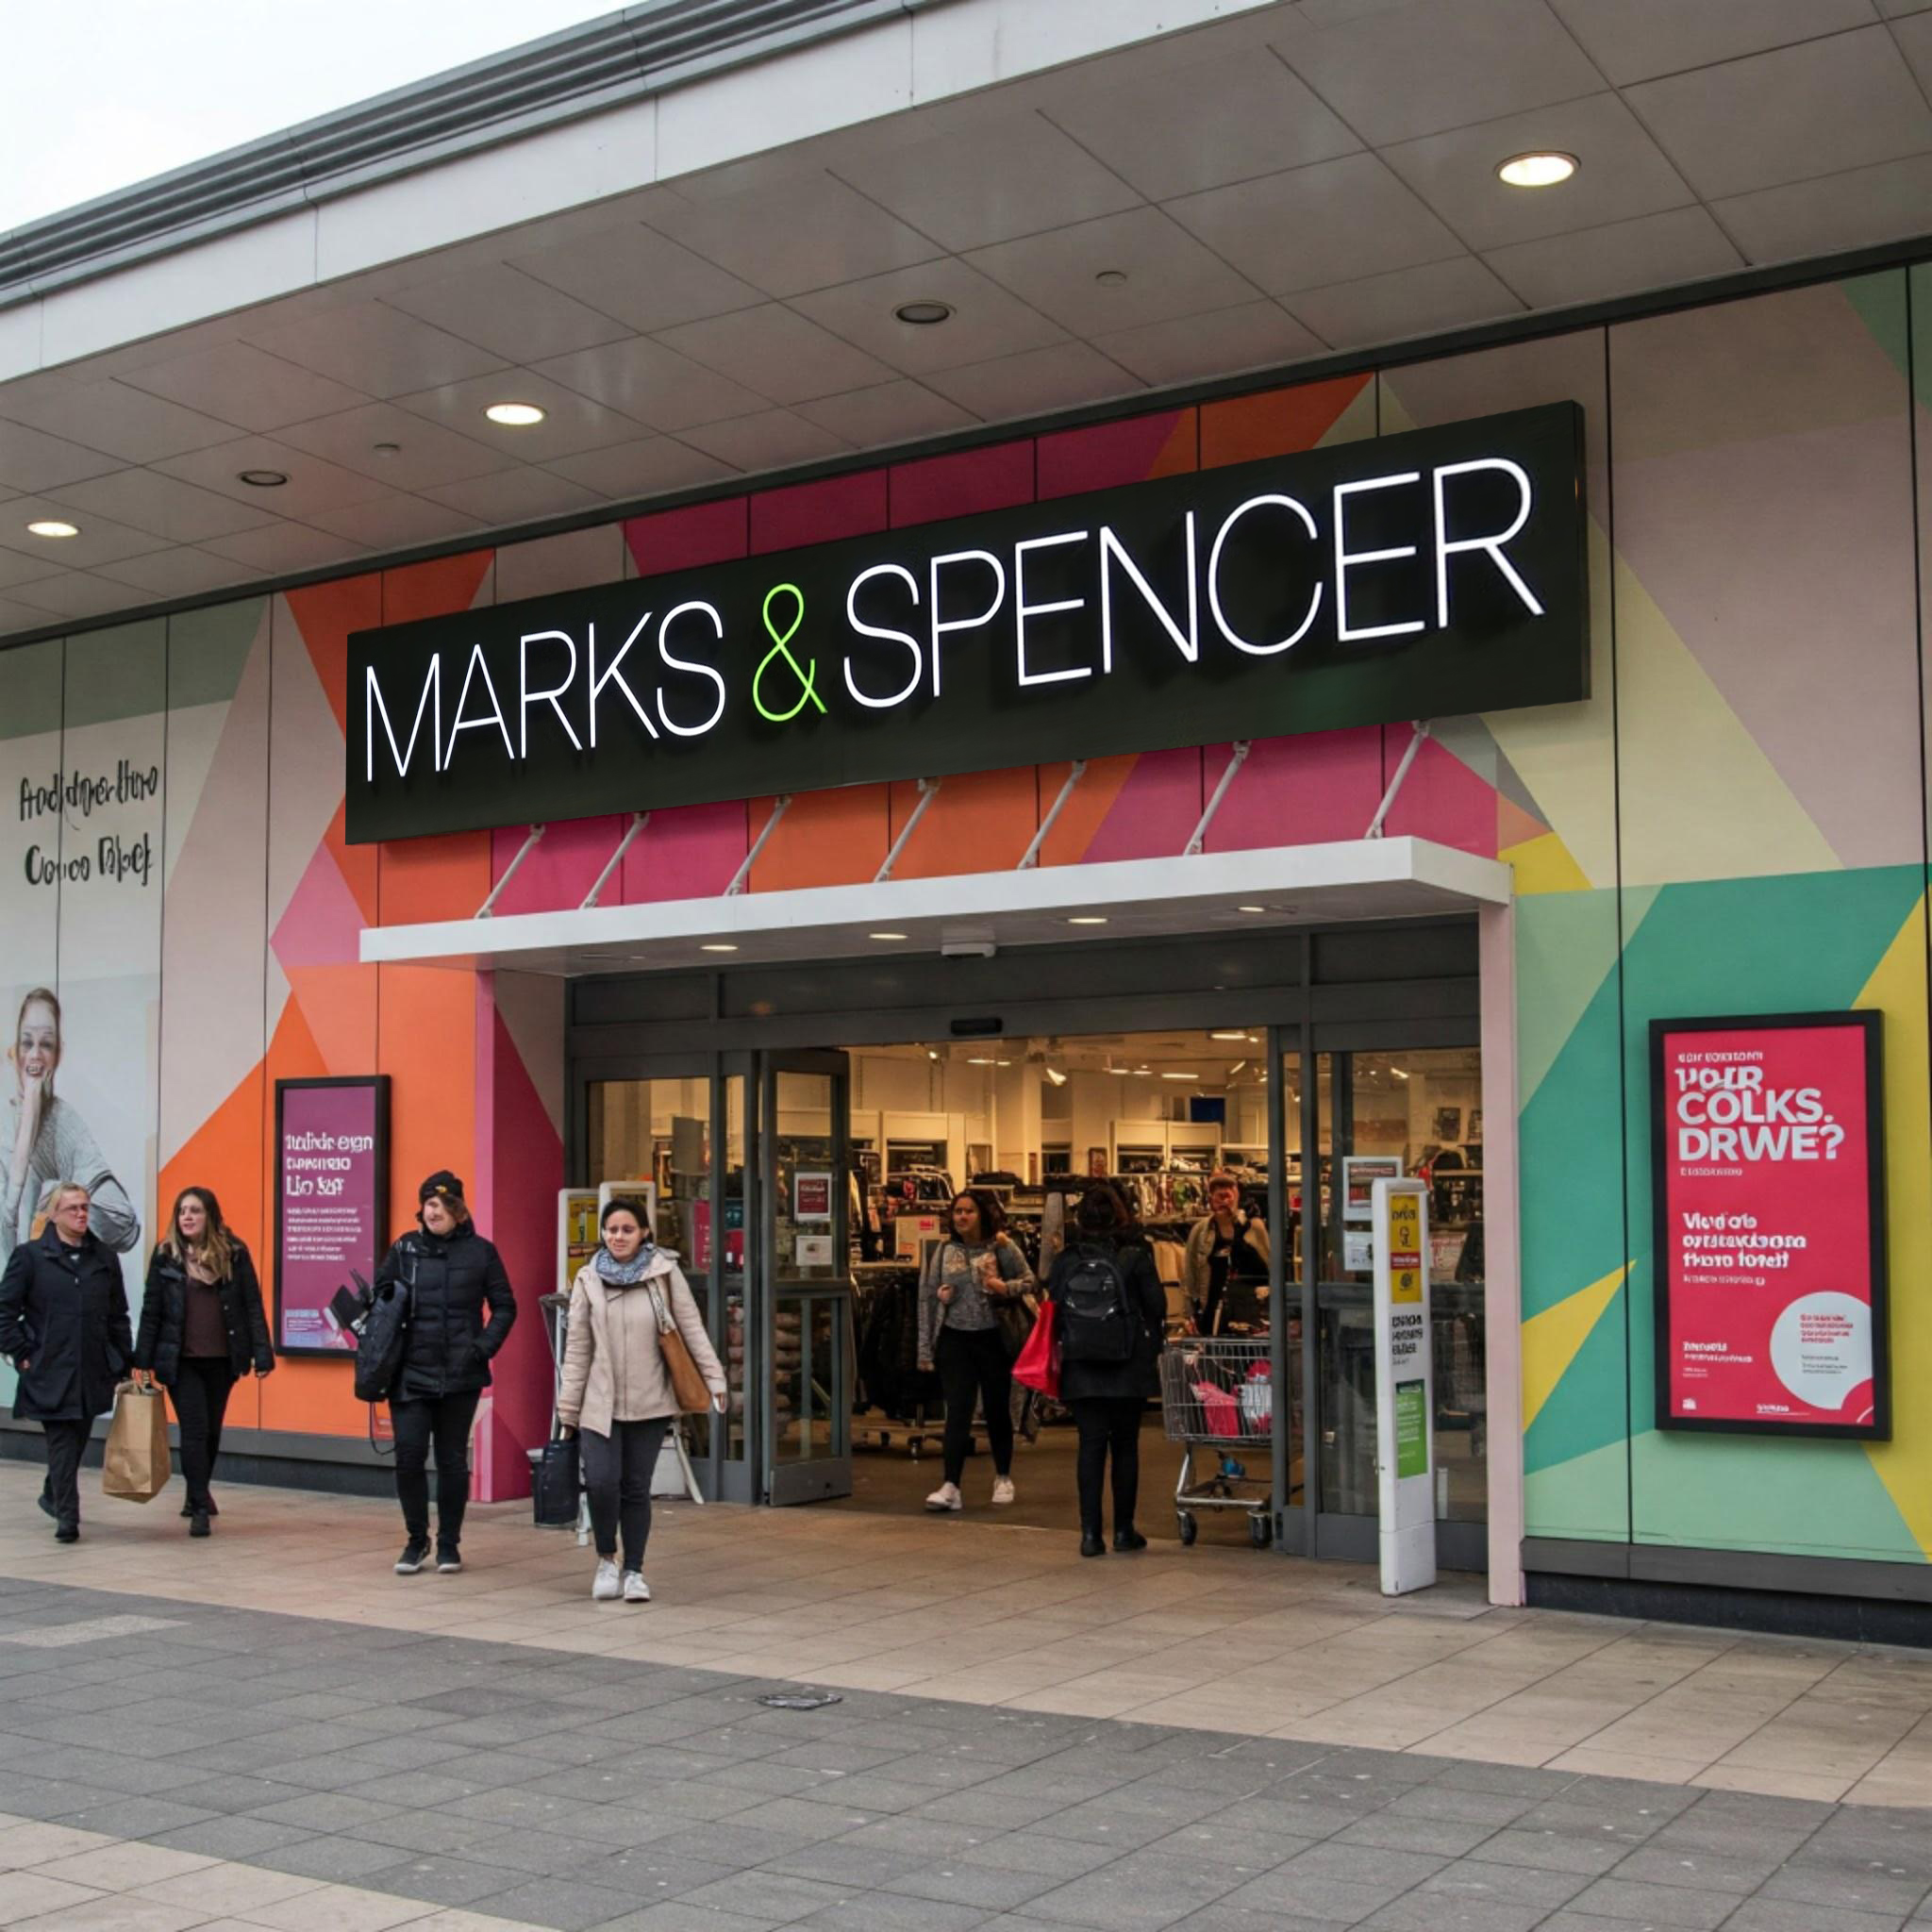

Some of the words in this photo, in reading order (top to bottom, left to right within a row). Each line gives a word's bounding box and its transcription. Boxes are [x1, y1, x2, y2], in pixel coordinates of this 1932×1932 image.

[366, 600, 726, 782] MARKS
[752, 583, 827, 722] &
[843, 458, 1544, 708] SPENCER
[1676, 1088, 1834, 1125] COLKS.
[1678, 1124, 1845, 1161] DRWE?
